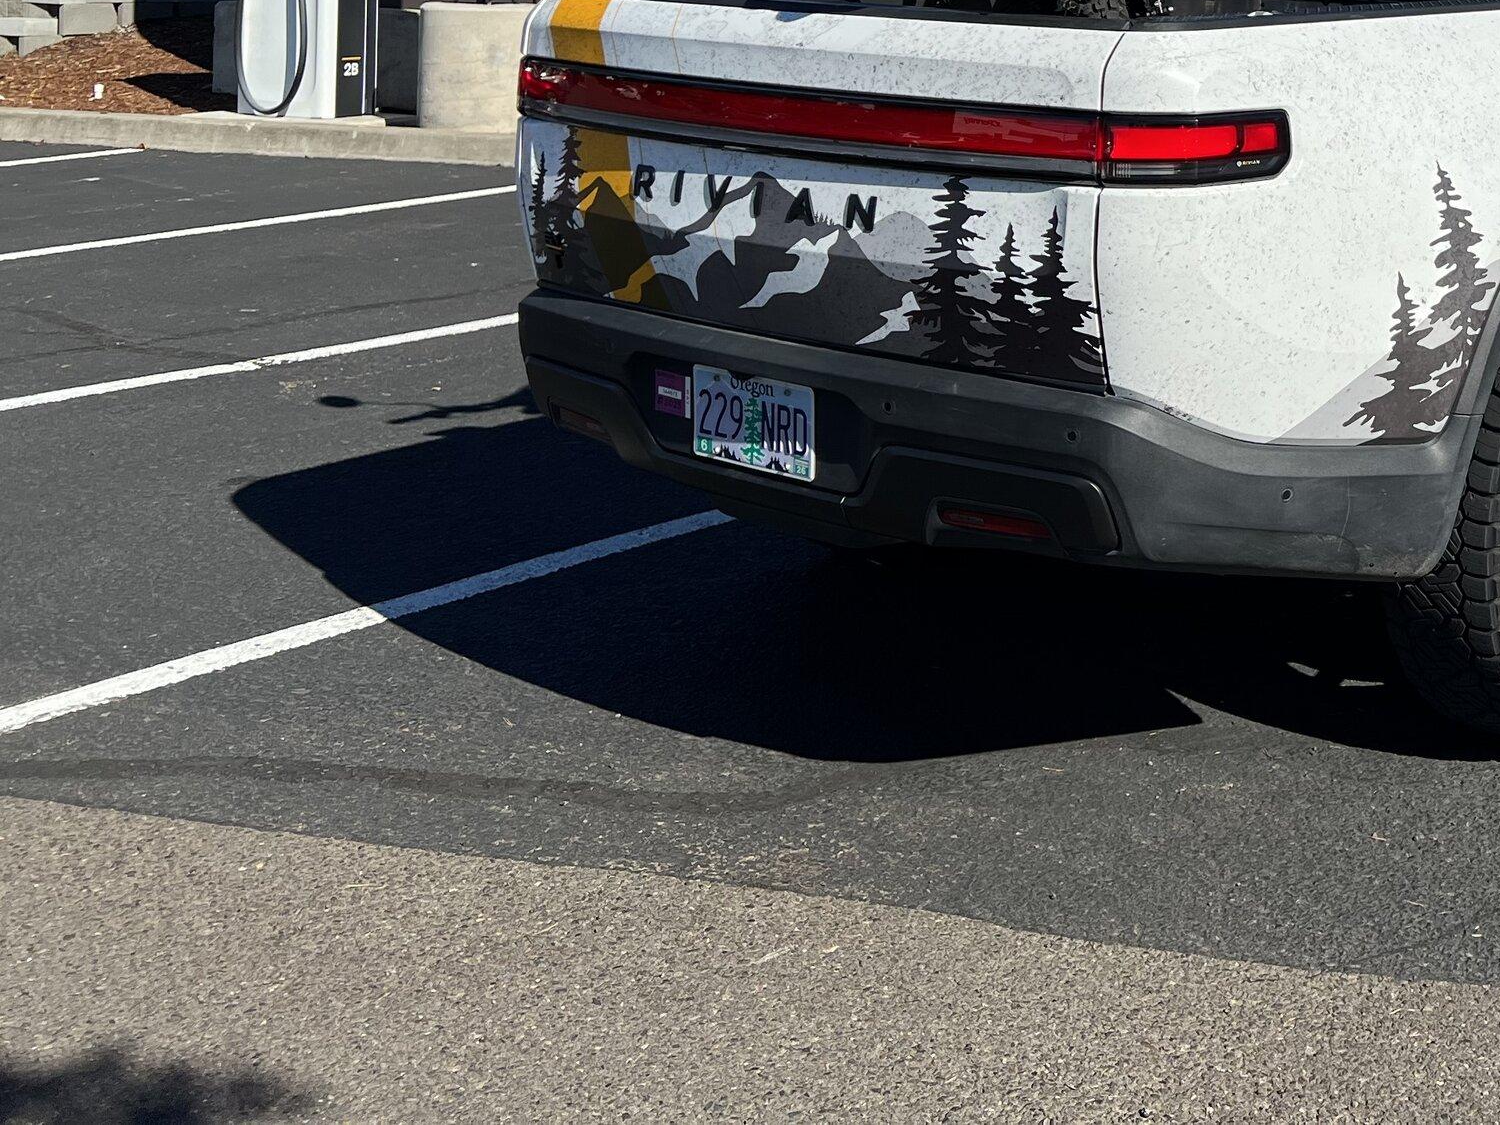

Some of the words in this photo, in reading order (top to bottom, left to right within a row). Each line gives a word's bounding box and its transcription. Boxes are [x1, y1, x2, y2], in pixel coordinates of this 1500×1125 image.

[632, 163, 878, 233] RIVIAN
[730, 377, 775, 398] Oregon
[699, 388, 744, 440] 229
[761, 400, 808, 456] NRD
[700, 438, 708, 451] 6
